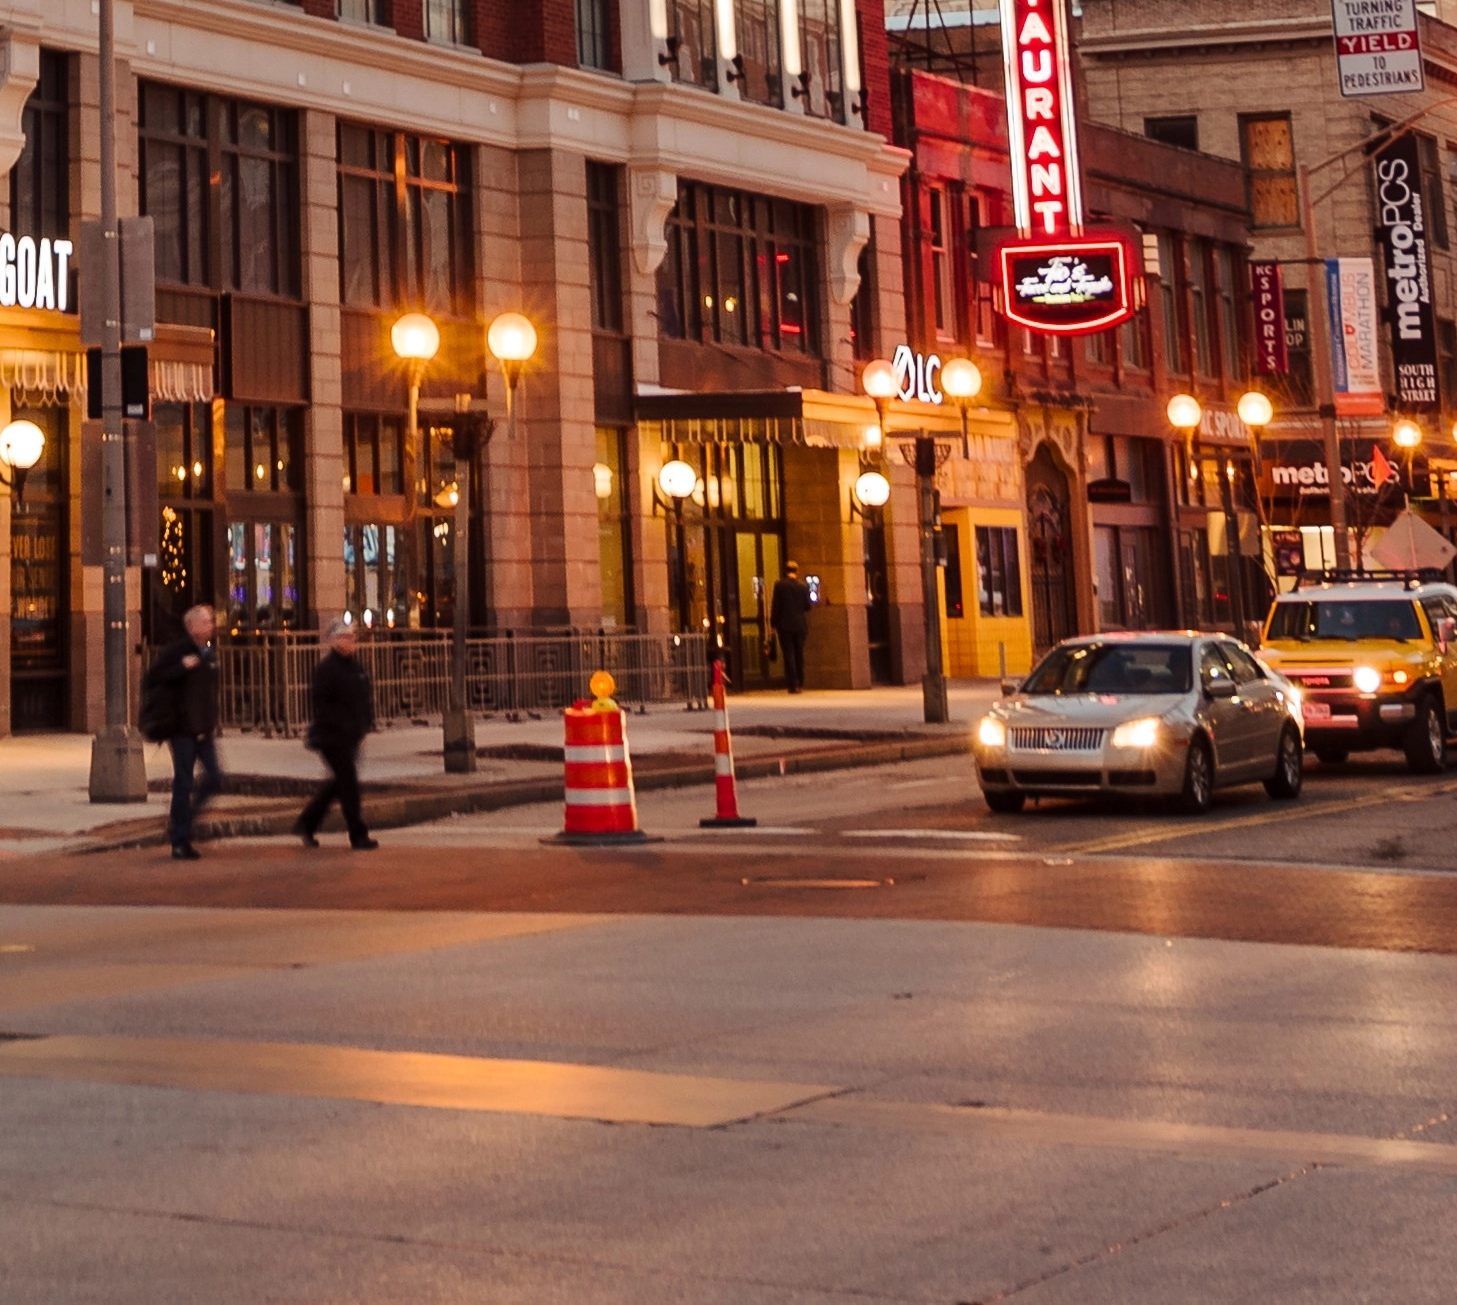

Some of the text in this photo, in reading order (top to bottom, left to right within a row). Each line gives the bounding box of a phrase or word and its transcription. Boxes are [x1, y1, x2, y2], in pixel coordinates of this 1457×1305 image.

[1348, 14, 1402, 31] TRAFFIC
[1341, 33, 1412, 53] YIELD
[1372, 55, 1386, 70] TO
[1344, 70, 1418, 88] PEDESTRIANS
[1378, 158, 1422, 339] metroPCS
[1411, 192, 1430, 304] Authorized Dealer
[0, 233, 73, 311] GOAT
[1255, 265, 1273, 276] KC
[1260, 277, 1277, 370] SPORTS
[1356, 272, 1374, 370] MARATHON
[1399, 364, 1434, 376] SOUTH
[1400, 377, 1435, 389] HIGH
[1401, 390, 1436, 402] STREET
